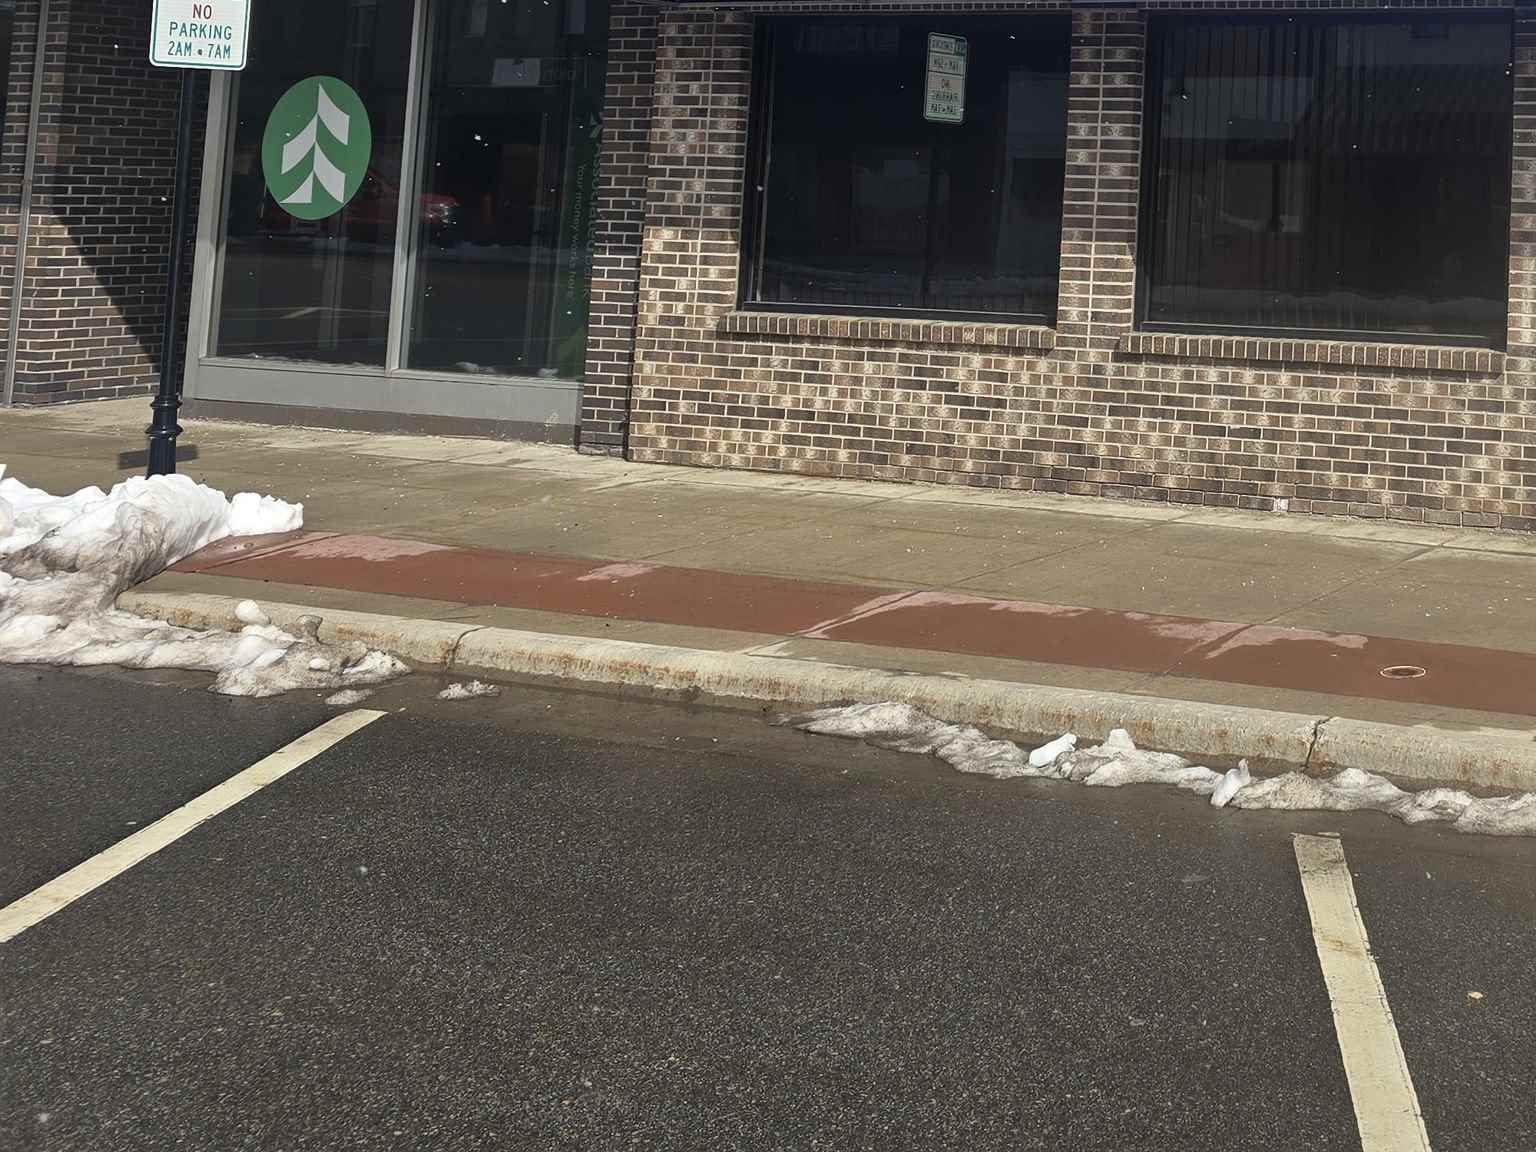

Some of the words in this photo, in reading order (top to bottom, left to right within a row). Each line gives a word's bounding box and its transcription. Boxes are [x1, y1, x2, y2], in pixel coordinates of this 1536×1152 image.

[192, 3, 213, 20] NO
[169, 21, 232, 41] PARKING
[168, 41, 192, 57] 2AM
[208, 43, 231, 59] 7AM
